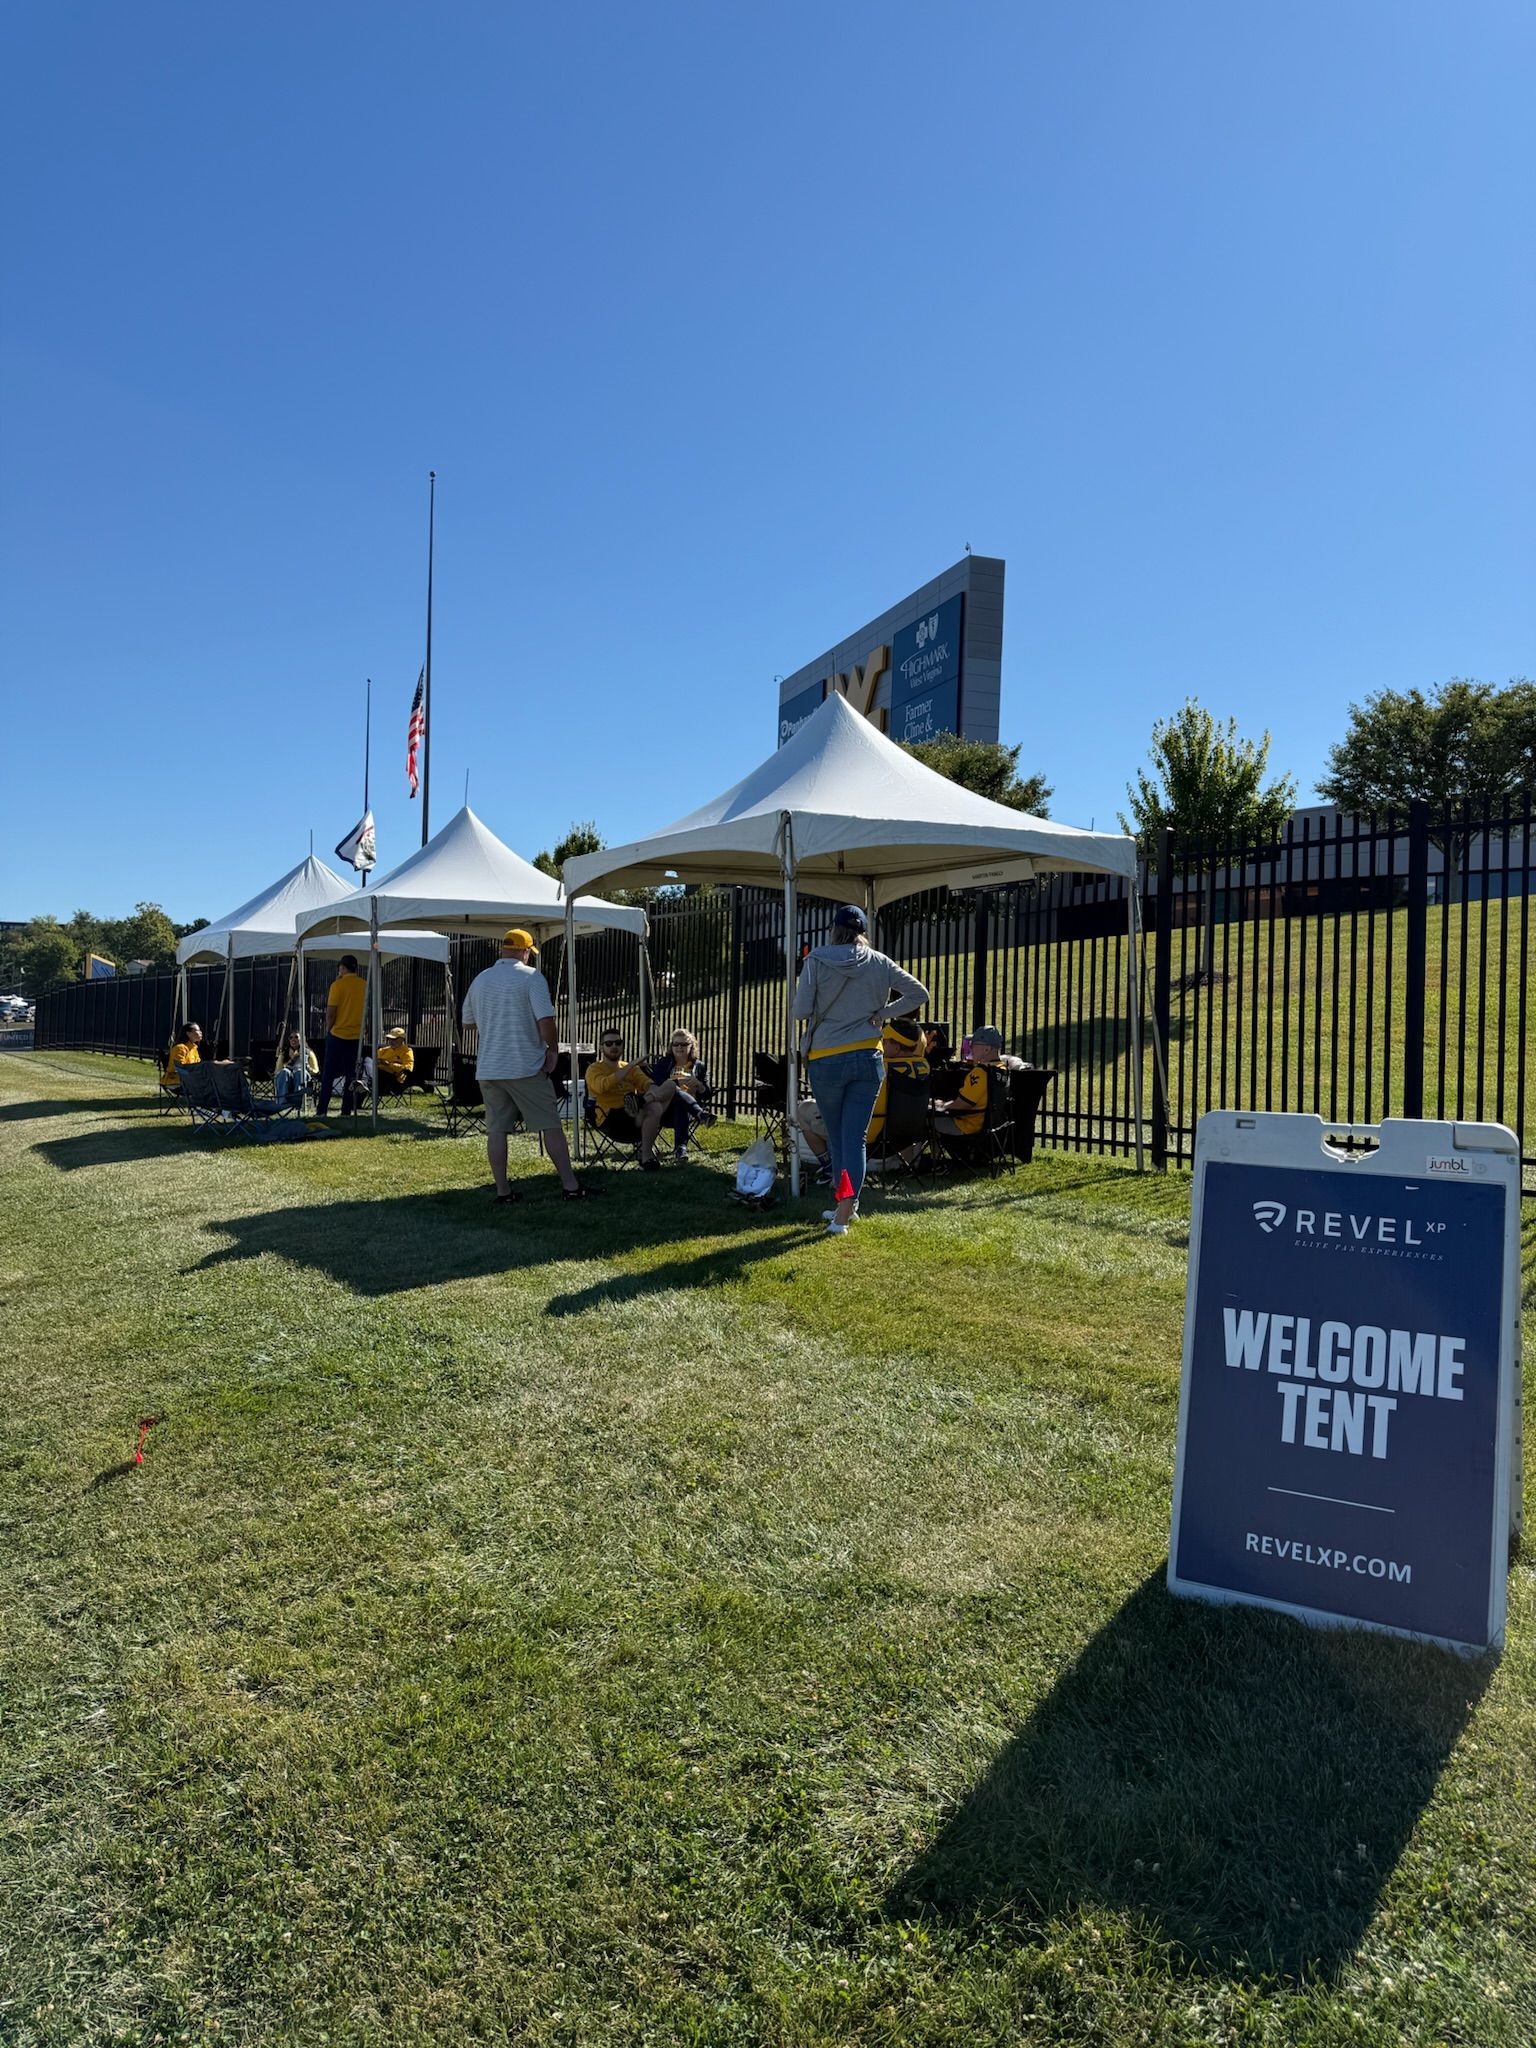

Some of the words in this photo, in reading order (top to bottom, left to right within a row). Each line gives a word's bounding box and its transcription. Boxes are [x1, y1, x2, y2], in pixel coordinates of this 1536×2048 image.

[901, 640, 950, 680] HIGHMARK
[909, 674, 923, 689] West
[924, 665, 943, 684] Virginia
[905, 698, 933, 722] Farmer
[925, 713, 934, 733] &
[1296, 1209, 1422, 1246] REVEL
[1425, 1221, 1447, 1234] XP
[1294, 1239, 1329, 1250] ELITE
[1334, 1243, 1356, 1252] FAN
[1360, 1246, 1445, 1262] EXPERIENCES
[1222, 1307, 1466, 1402] WELCOME
[1276, 1381, 1398, 1461] TENT
[1245, 1531, 1413, 1585] REVELXP.COM
